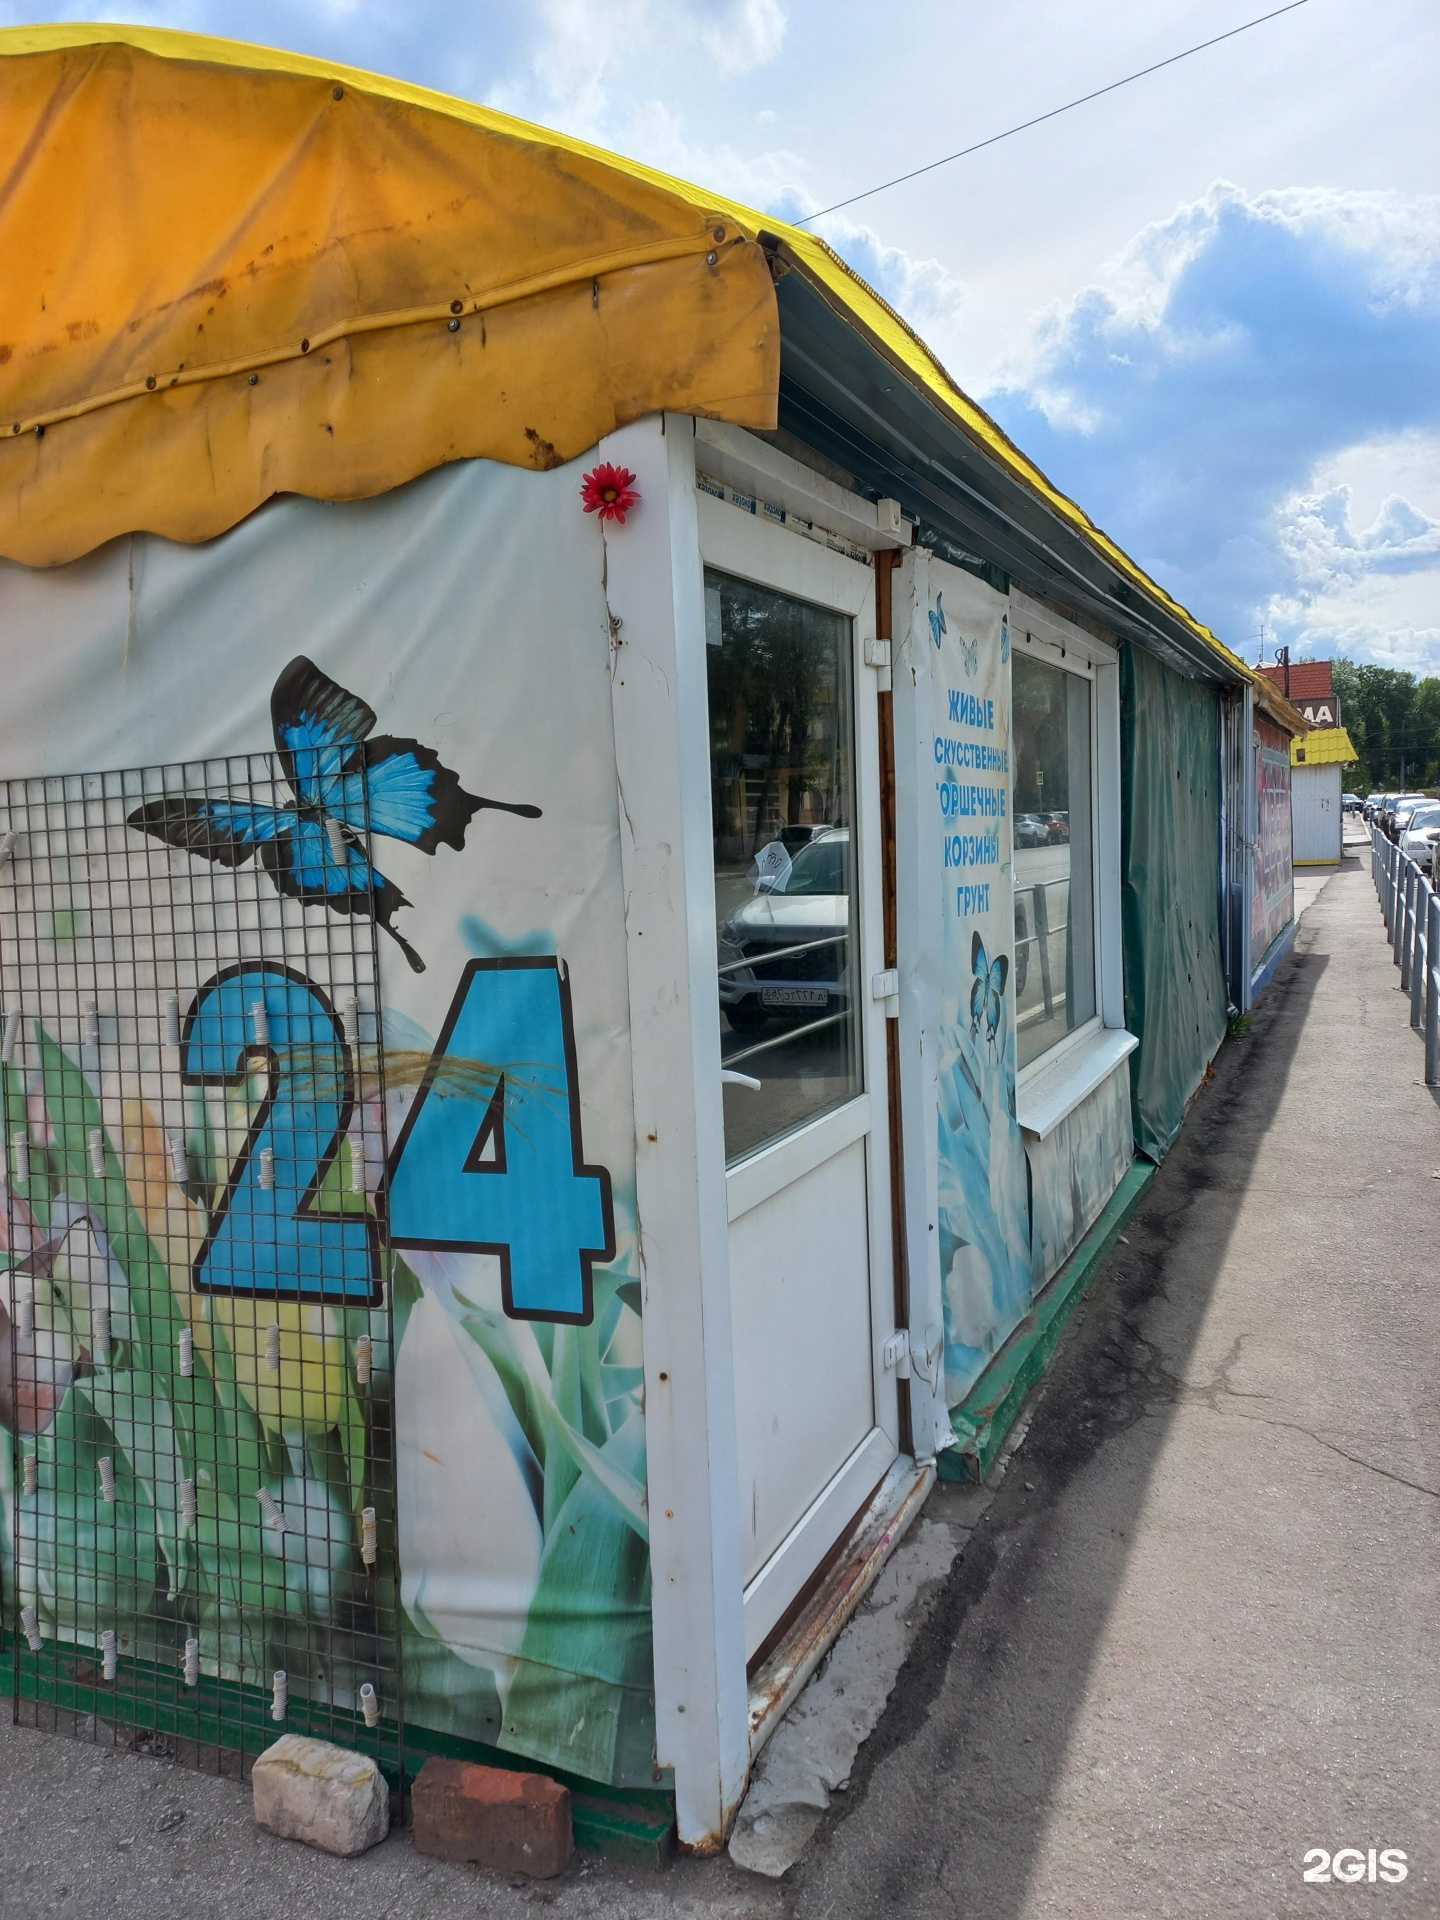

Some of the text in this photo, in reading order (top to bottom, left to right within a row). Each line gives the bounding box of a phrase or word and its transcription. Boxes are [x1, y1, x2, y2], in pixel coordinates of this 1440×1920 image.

[948, 688, 994, 730] ЖИВЫЕ
[934, 736, 1009, 773] СКУССТВЕННЫЕ
[935, 782, 1006, 817] ОРШЕЧНЫЕ
[944, 835, 999, 867] КОРЗИНЫ
[957, 883, 991, 917] ГРУНТ
[180, 955, 616, 1327] 24
